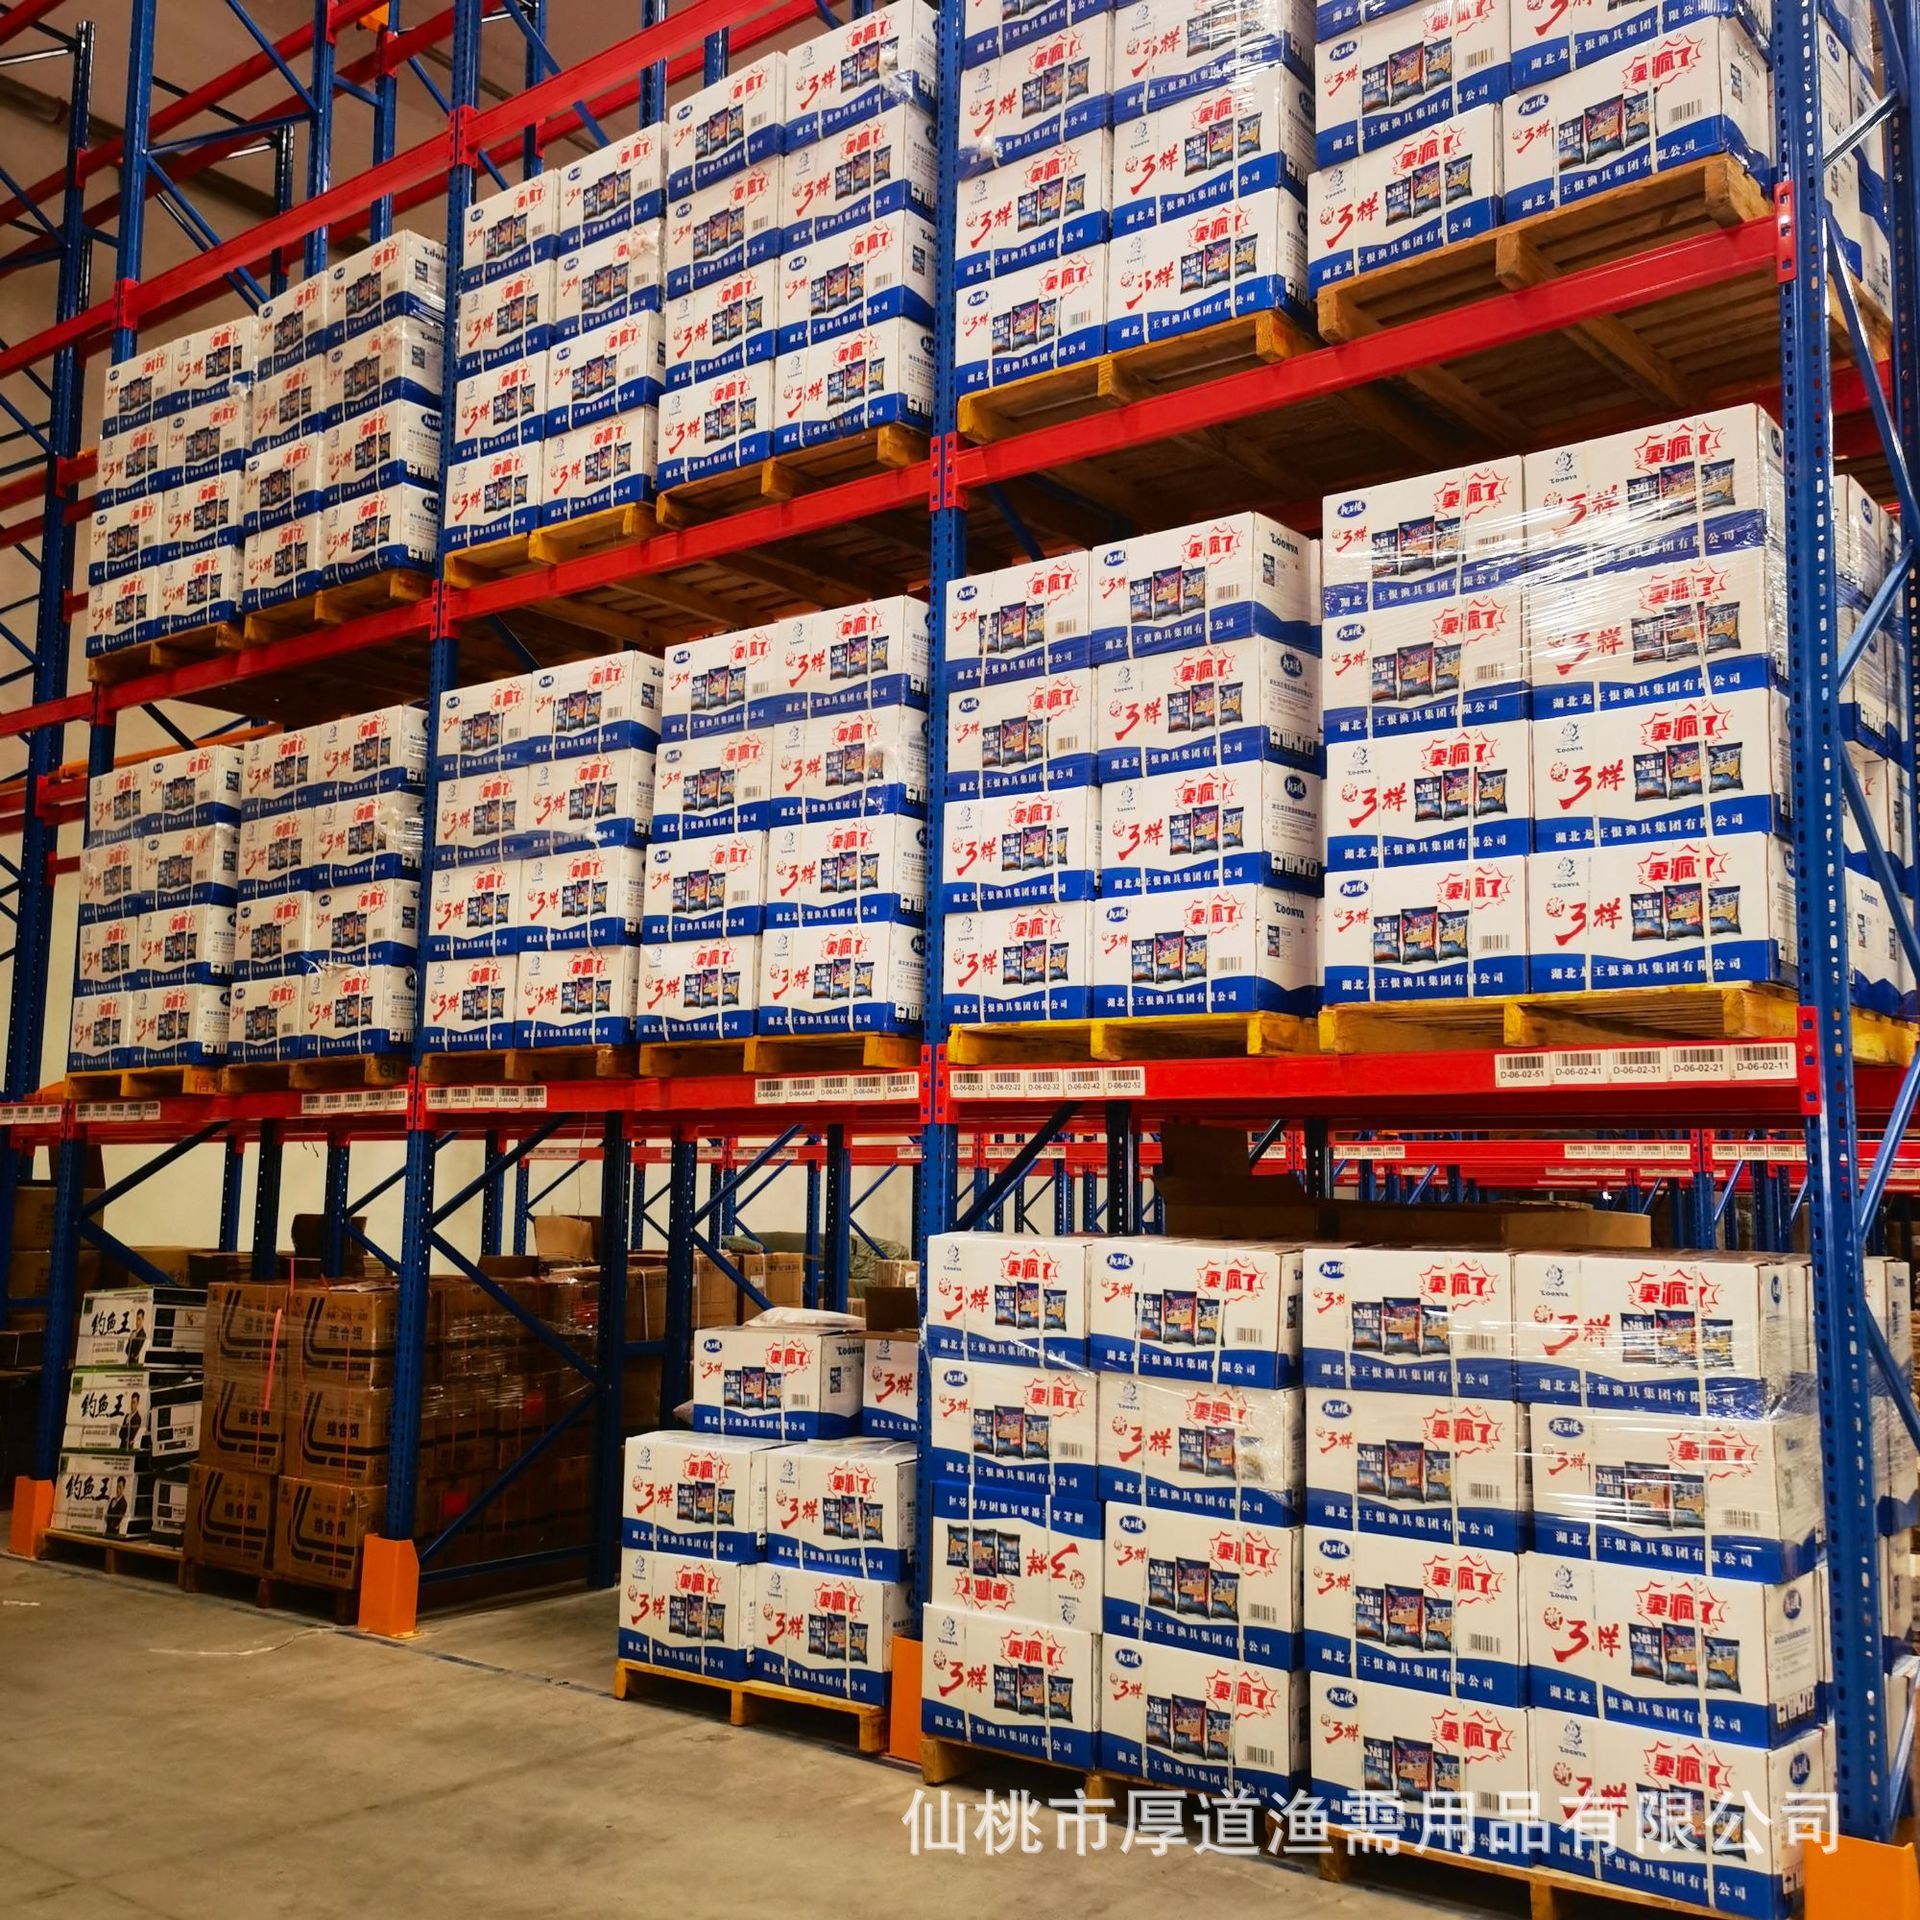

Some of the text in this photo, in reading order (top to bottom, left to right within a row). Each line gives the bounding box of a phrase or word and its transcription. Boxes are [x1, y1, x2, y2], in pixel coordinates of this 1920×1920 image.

[1632, 46, 1694, 84] 卖疯了
[1442, 481, 1498, 508] 卖疯了
[1189, 535, 1233, 559] 卖疯了
[1270, 533, 1298, 555] LOONVA
[1032, 573, 1072, 595] 卖疯了
[1181, 659, 1225, 681] 卖疯了
[1034, 689, 1072, 709] 卖疯了
[1652, 716, 1714, 741] 卖疯了
[1430, 743, 1484, 767] 卖疯了
[1015, 803, 1052, 825] 卖疯了
[832, 831, 866, 849] 卖疯了
[1191, 905, 1236, 925] 卖疯了
[1275, 902, 1304, 919] LOONVA
[827, 938, 861, 955] 卖疯了
[1501, 1070, 1544, 1078] D-06-02-51
[1556, 1067, 1601, 1076] D-06-02-41
[1613, 1066, 1661, 1074] D-06-02-31
[1674, 1064, 1724, 1072] D-06-02-21
[1737, 1062, 1789, 1071] D-06-02-11
[1204, 1269, 1256, 1292] 卖疯了
[1428, 1273, 1485, 1296] 卖疯了
[771, 1349, 804, 1366] 卖疯了
[1031, 1388, 1076, 1408] 卖疯了
[1432, 1419, 1491, 1443] 卖疯了
[1431, 1565, 1491, 1593] 卖疯了
[1648, 1595, 1714, 1624] 卖疯了
[1007, 1640, 1055, 1665] 卖疯了
[1214, 1680, 1268, 1710] 卖疯了
[1440, 1721, 1499, 1749] 卖疯了
